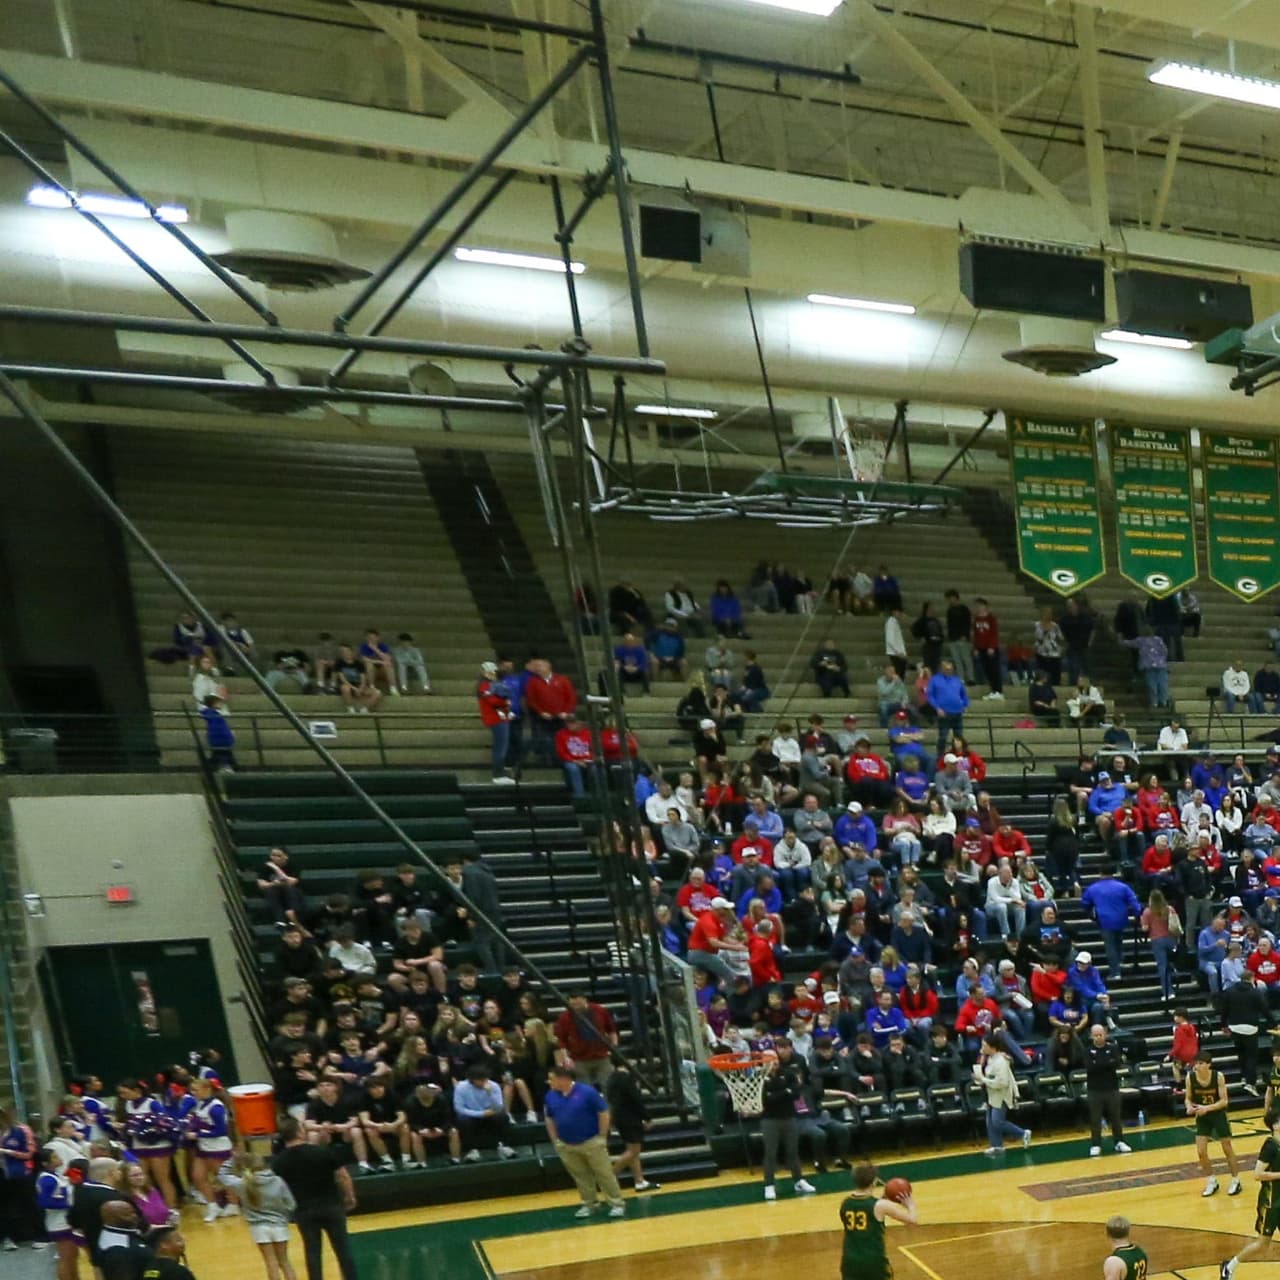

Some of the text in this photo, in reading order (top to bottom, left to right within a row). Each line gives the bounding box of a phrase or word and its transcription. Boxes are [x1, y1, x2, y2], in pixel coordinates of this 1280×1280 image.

[1027, 422, 1077, 436] BASEBALL
[1120, 438, 1179, 451] BASKETBALL
[845, 1210, 867, 1231] 33
